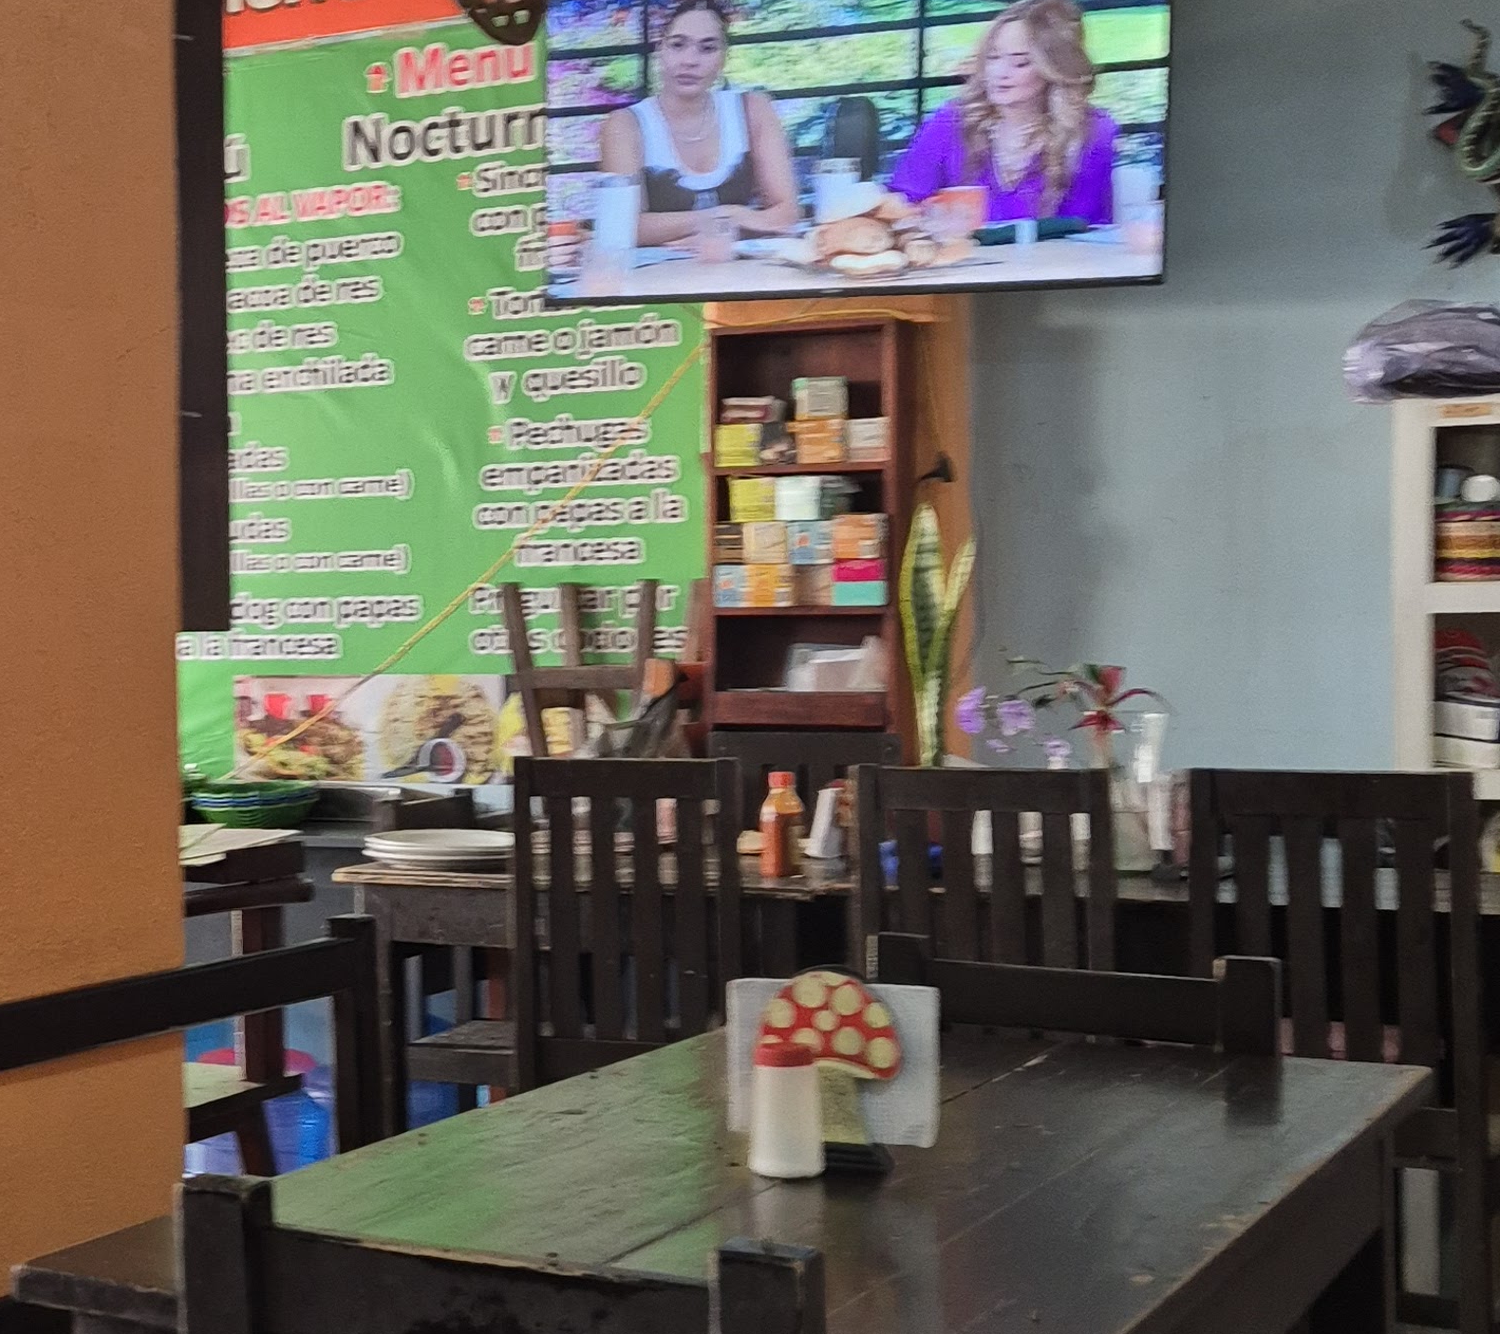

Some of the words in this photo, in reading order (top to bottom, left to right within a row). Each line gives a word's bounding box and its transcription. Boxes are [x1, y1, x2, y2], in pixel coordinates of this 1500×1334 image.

[397, 44, 536, 97] Menu
[293, 182, 399, 220] VAPOR:
[265, 236, 300, 268] de
[303, 232, 403, 270] puerco
[297, 274, 333, 307] de
[335, 276, 383, 303] res
[252, 321, 289, 351] de
[291, 323, 338, 349] res
[465, 330, 550, 360] carne
[553, 328, 576, 354] o
[576, 313, 681, 359] jamón
[262, 354, 393, 393] enchilada
[489, 372, 516, 403] y
[522, 356, 646, 401] quesillo
[506, 414, 650, 451] Pechugas
[479, 450, 680, 494] empanizadas
[474, 502, 529, 529] con
[531, 499, 627, 533] papas
[628, 497, 650, 524] a
[652, 488, 688, 522] la
[515, 534, 645, 566] francesa
[285, 598, 333, 623] con
[335, 596, 423, 628] papas
[229, 629, 341, 659] francesa
